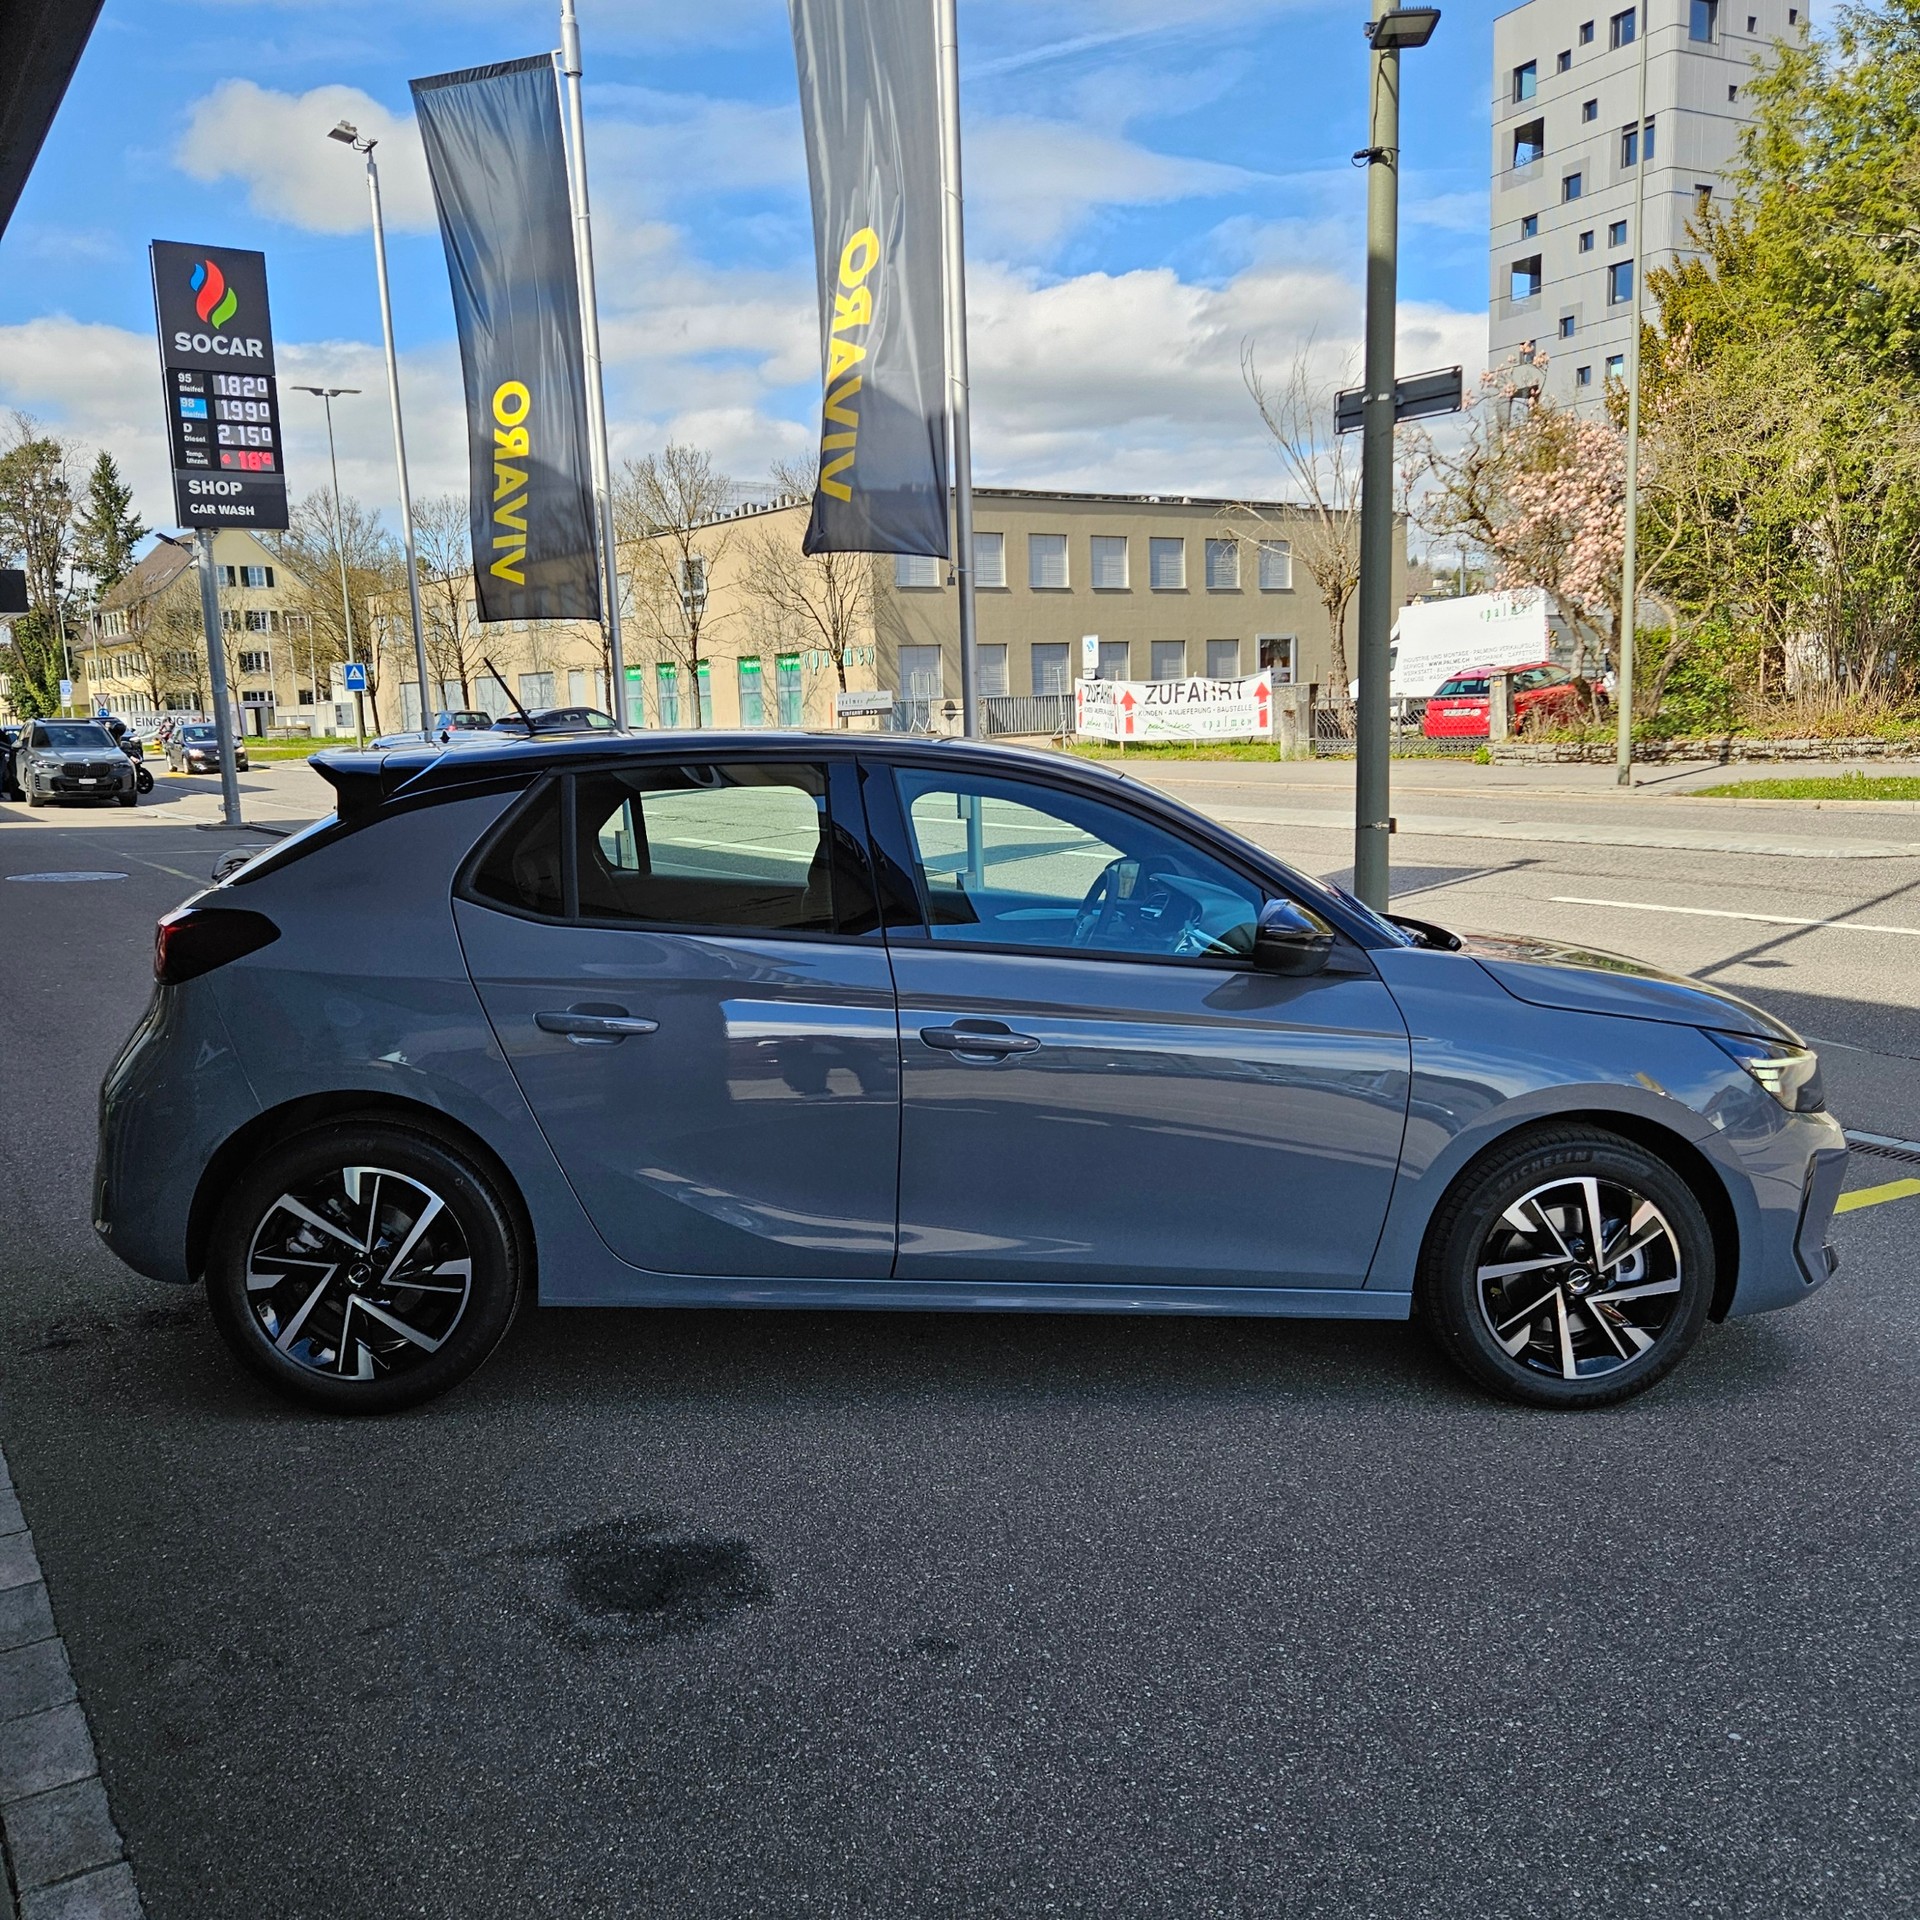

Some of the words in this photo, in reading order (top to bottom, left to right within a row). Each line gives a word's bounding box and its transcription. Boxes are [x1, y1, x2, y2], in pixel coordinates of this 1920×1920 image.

[174, 332, 264, 358] SOCAR
[178, 373, 192, 383] 95
[180, 398, 195, 408] 98
[182, 422, 193, 433] D
[184, 435, 206, 443] Diesel
[188, 479, 243, 496] SHOP
[189, 503, 217, 515] CAR
[218, 504, 255, 516] WASH
[1144, 680, 1246, 705] ZUFAHRT
[1216, 704, 1253, 712] BAUSTELLE
[1498, 1151, 1588, 1191] MICHELIN
